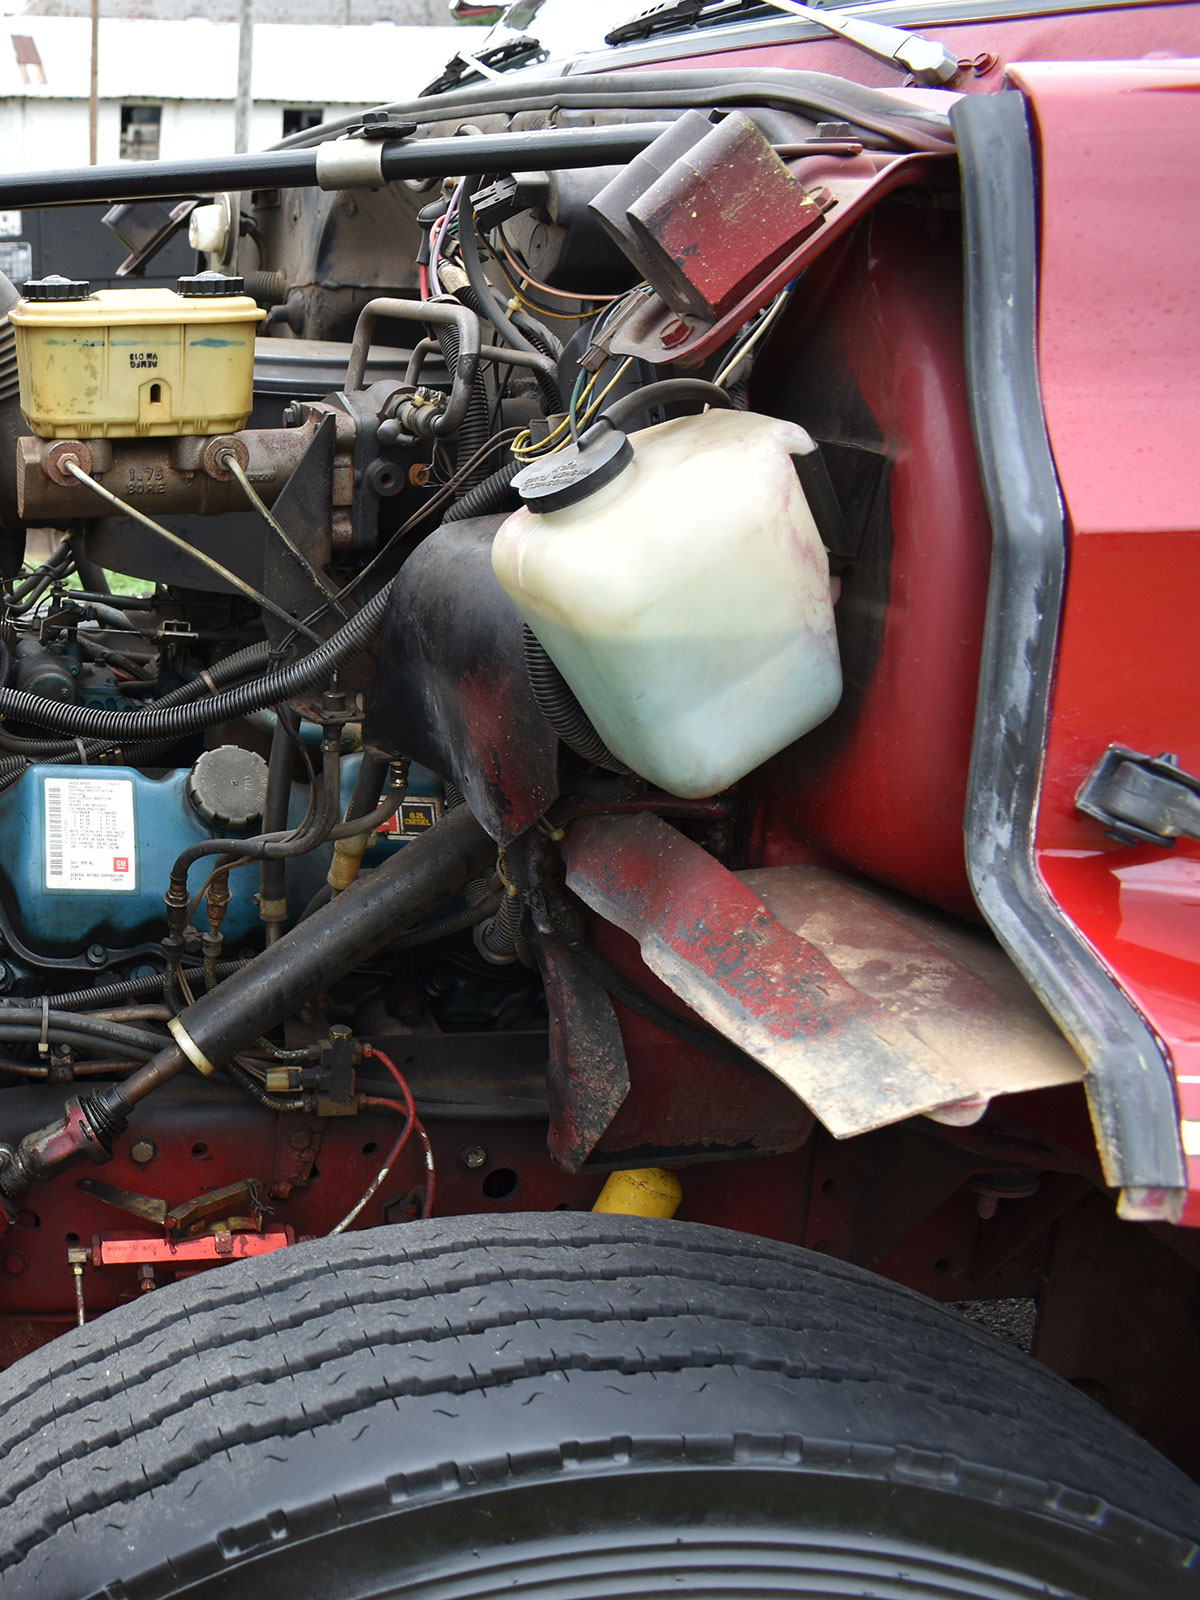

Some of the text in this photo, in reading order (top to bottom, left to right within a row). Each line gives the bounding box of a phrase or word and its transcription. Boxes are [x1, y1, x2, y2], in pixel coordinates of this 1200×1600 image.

[128, 466, 164, 482] 1.75
[126, 483, 167, 495] BORE
[404, 818, 432, 826] DIESEL
[116, 859, 126, 867] GM
